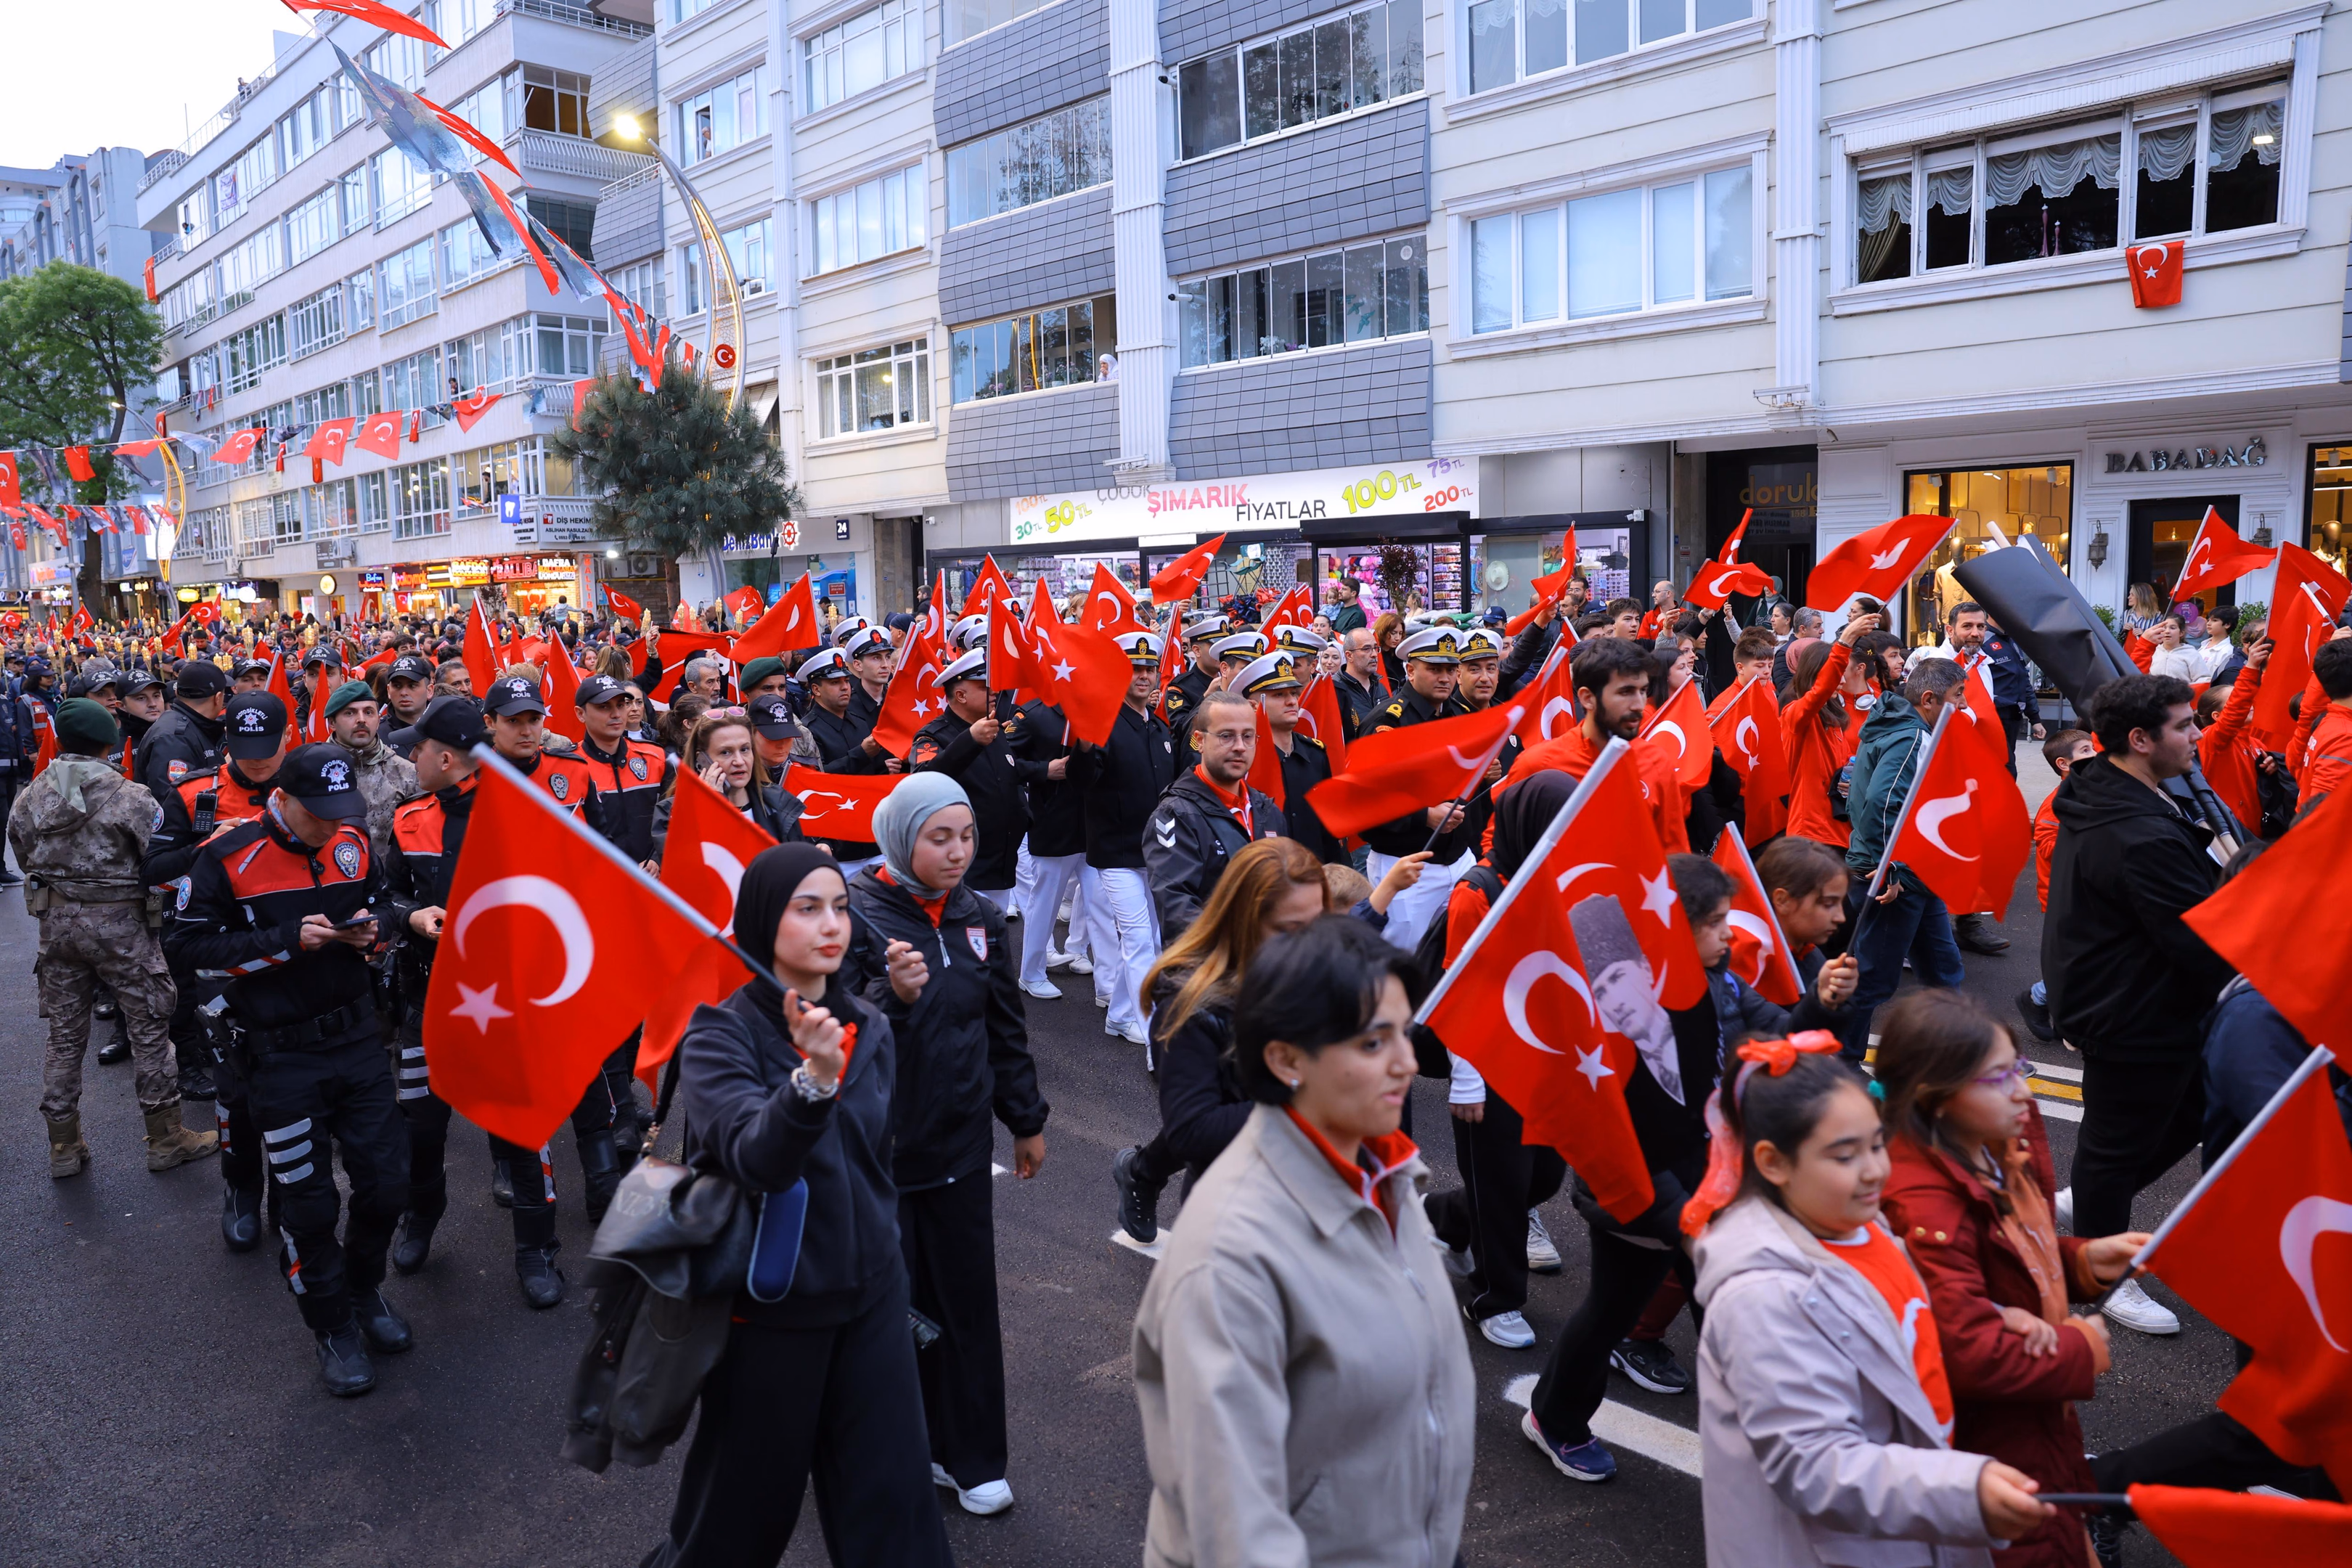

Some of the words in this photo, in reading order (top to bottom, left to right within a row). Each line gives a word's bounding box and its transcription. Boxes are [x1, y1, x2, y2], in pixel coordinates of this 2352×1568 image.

[2104, 437, 2267, 473] BABADAĞ
[1148, 483, 1248, 518] ŞIMARIK
[1236, 499, 1326, 521] FİYATLAR
[837, 522, 848, 533] 24
[328, 782, 350, 791] POLİS
